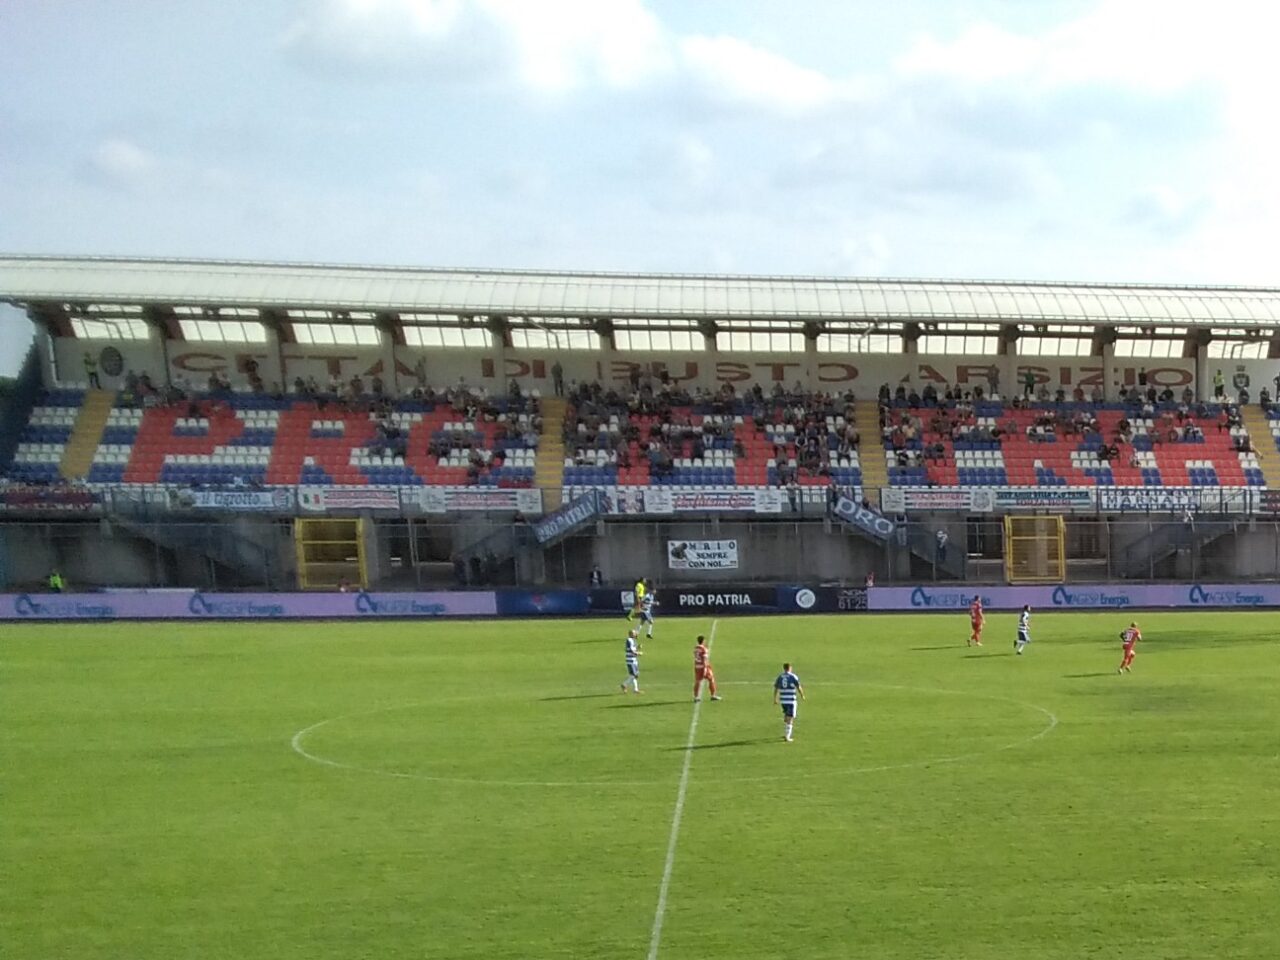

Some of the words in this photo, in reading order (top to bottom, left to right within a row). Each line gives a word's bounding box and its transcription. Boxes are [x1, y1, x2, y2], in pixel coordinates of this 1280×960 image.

[835, 496, 895, 535] PRO
[679, 594, 705, 606] PRO
[707, 593, 752, 606] PATRIA
